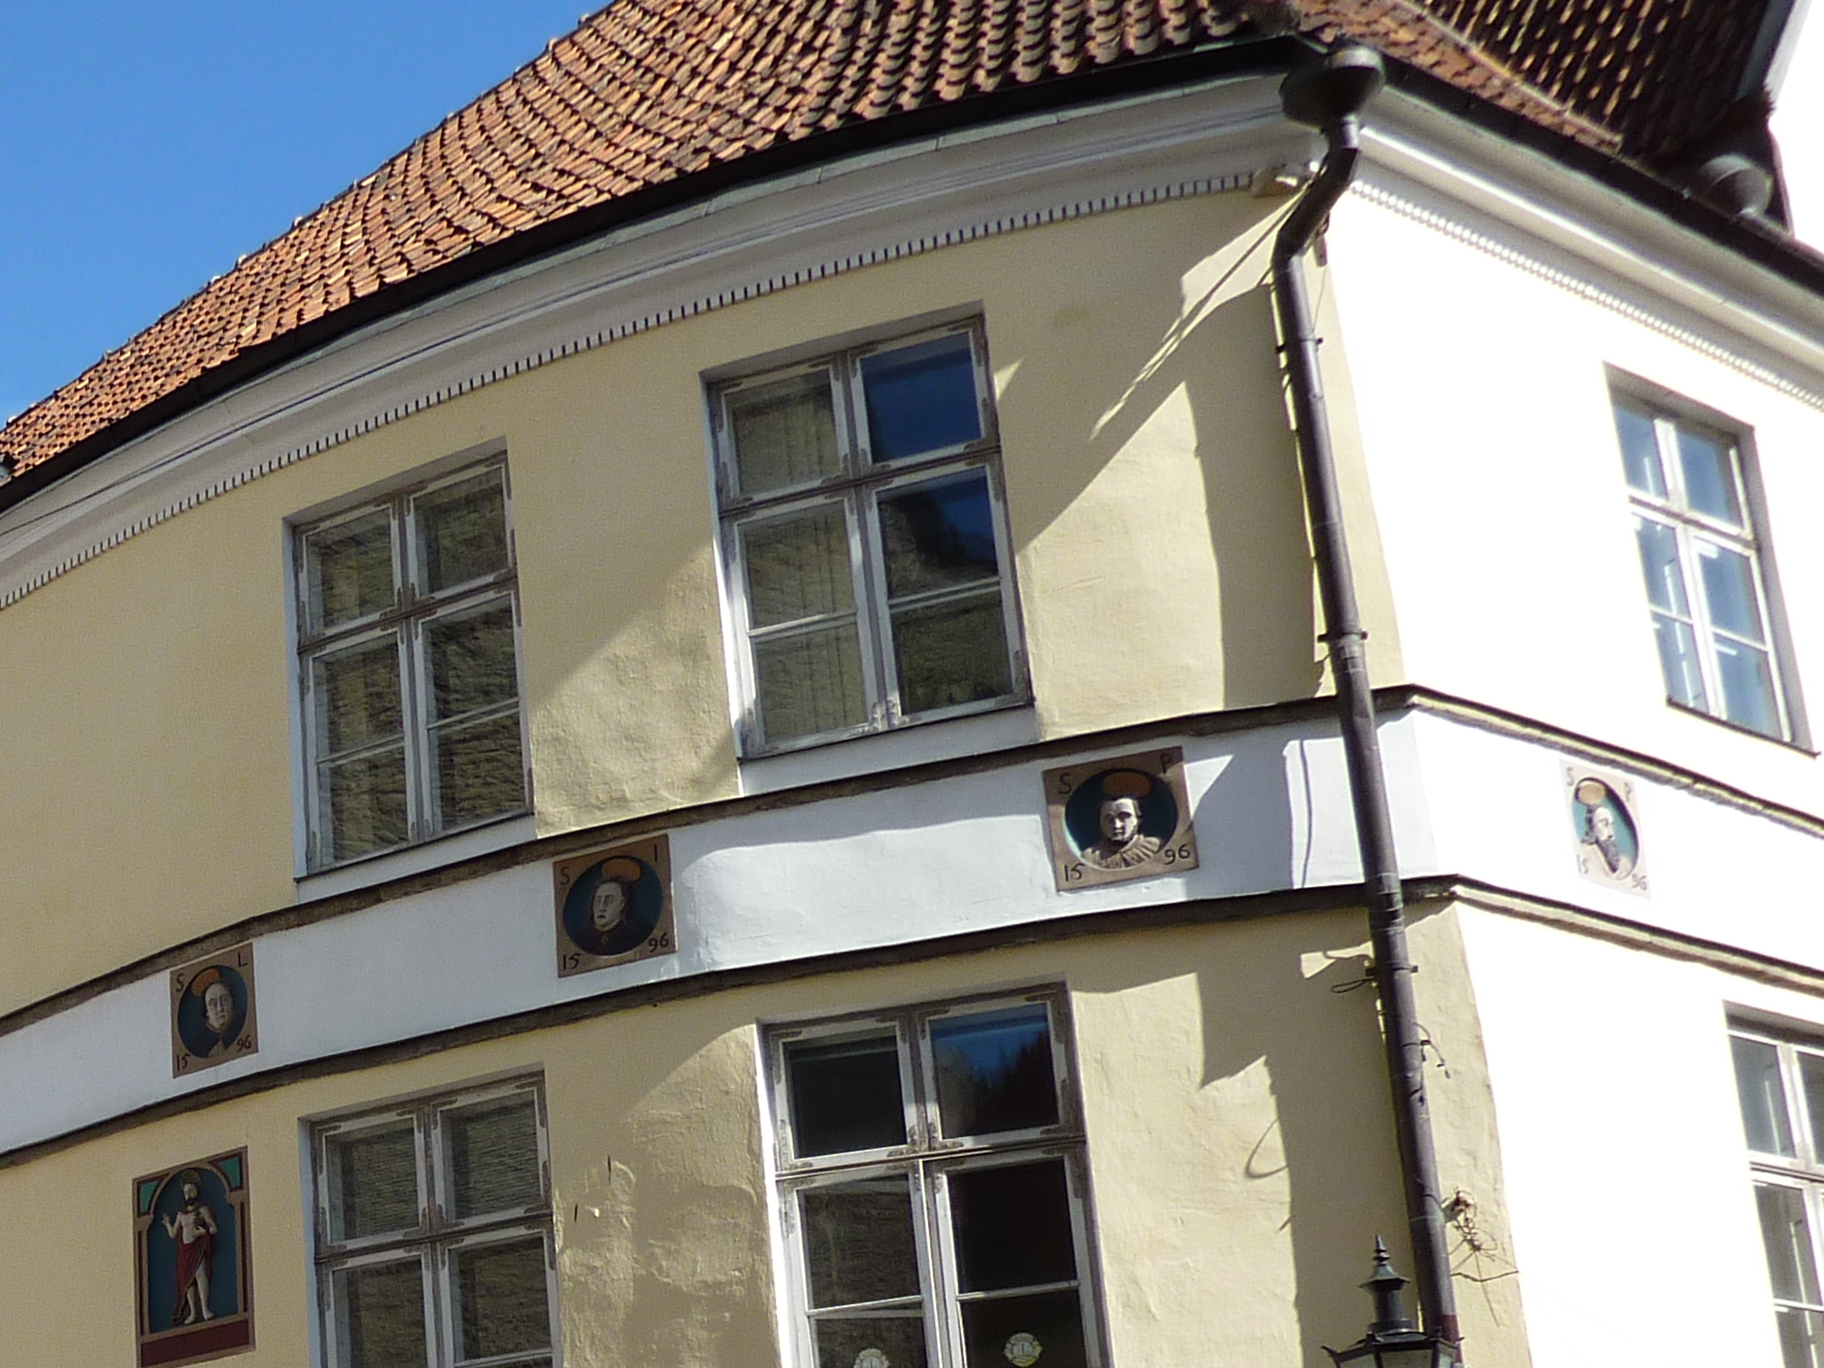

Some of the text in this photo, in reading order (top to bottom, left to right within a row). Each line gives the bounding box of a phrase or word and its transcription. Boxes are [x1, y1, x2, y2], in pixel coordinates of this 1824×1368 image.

[1058, 753, 1173, 795] S P
[1565, 766, 1575, 787] S
[559, 865, 571, 886] S
[1063, 843, 1191, 882] 15 96
[562, 932, 670, 970] 15 96
[176, 952, 249, 993] S L
[176, 1034, 252, 1071] 15 96
